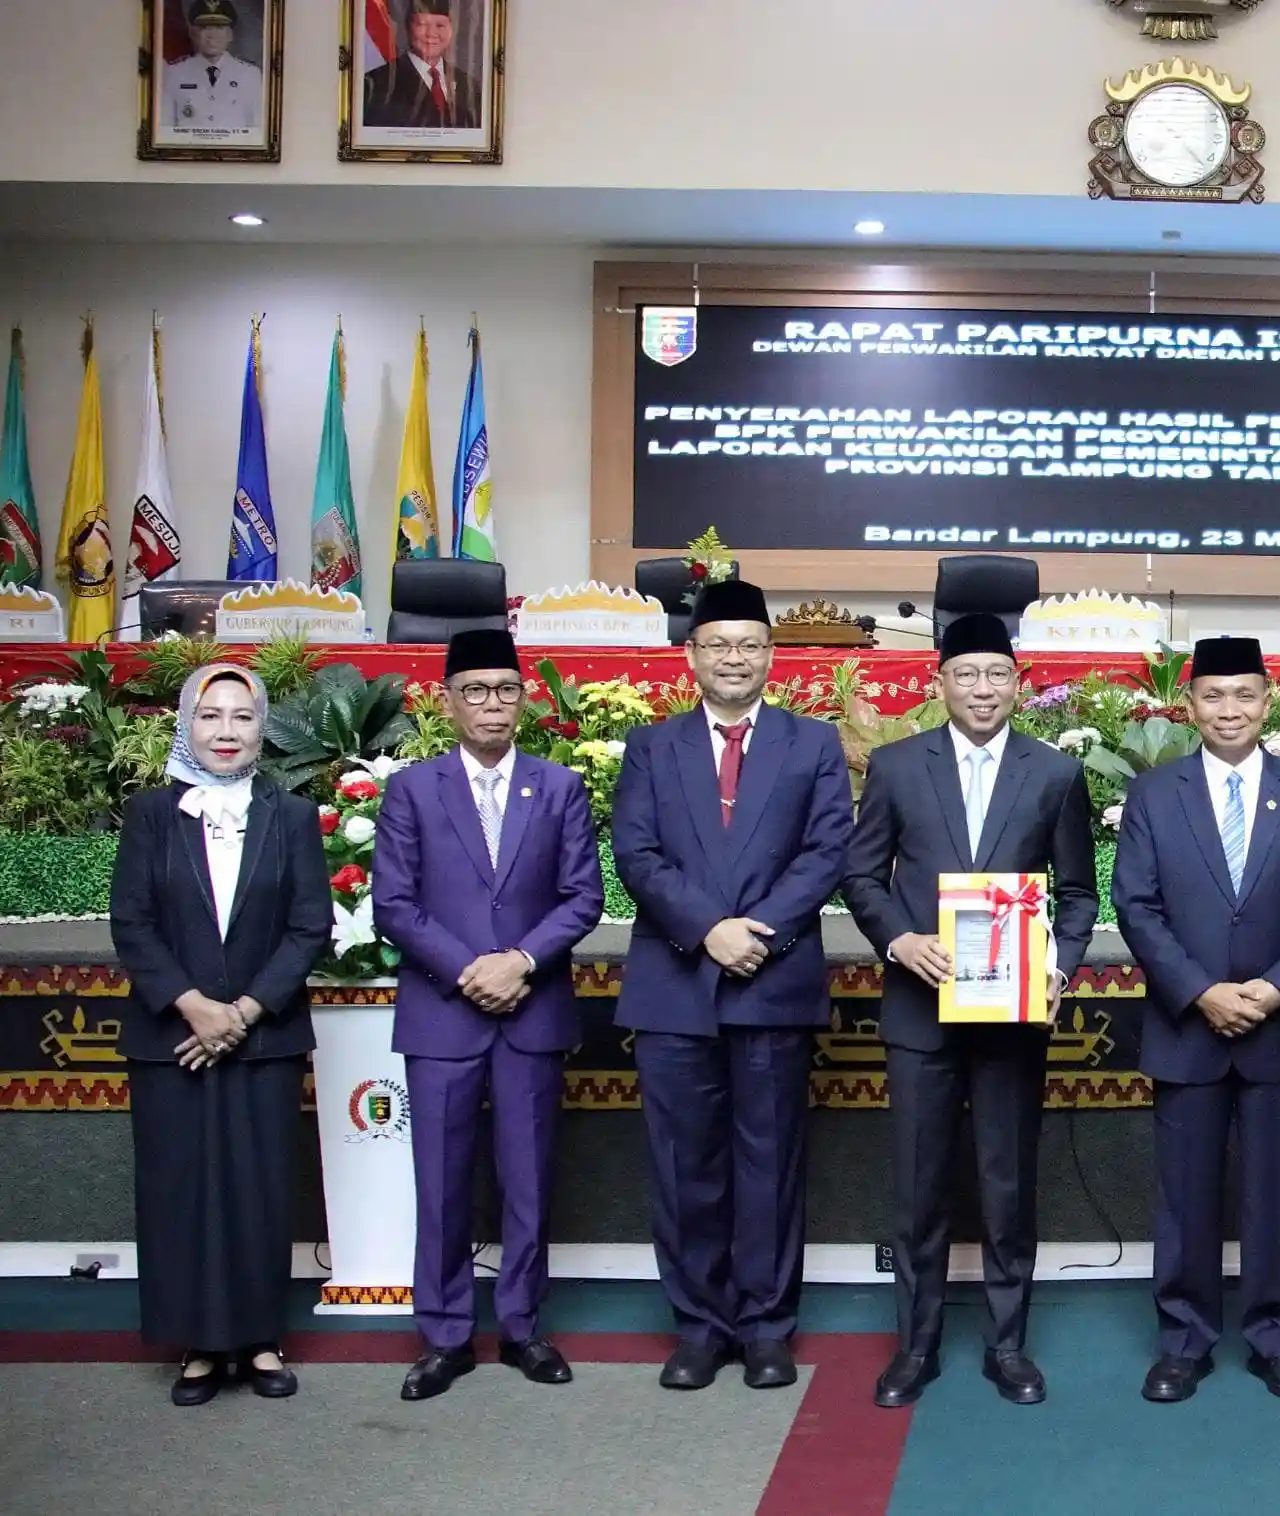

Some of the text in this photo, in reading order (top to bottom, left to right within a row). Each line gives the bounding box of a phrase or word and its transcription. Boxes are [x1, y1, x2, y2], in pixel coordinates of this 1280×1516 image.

[784, 321, 944, 341] RAPAT
[957, 324, 1243, 347] PARIPURNA
[753, 341, 852, 353] DEWAN
[860, 342, 1038, 357] PERWAKILAN
[1045, 345, 1150, 359] RAKYAT
[1156, 348, 1264, 361] DAERAH
[645, 407, 912, 422] PENYERAHAN
[925, 410, 1107, 426] LAPORAN
[1121, 412, 1235, 428] HASIL
[715, 424, 795, 439] BPK
[807, 425, 1063, 442] PERWAKILAN
[1075, 428, 1258, 446] PROVINSI
[648, 440, 832, 456] LAPORAN
[845, 442, 1063, 459] KEUANGAN
[825, 460, 1009, 476] PROVINSI
[1021, 461, 1213, 479] LAMPUNG
[140, 502, 180, 555] MESUJI
[239, 496, 274, 546] METRO
[864, 526, 998, 543] Bandar
[1008, 527, 1191, 549] Lampung,
[1201, 529, 1245, 546] 23
